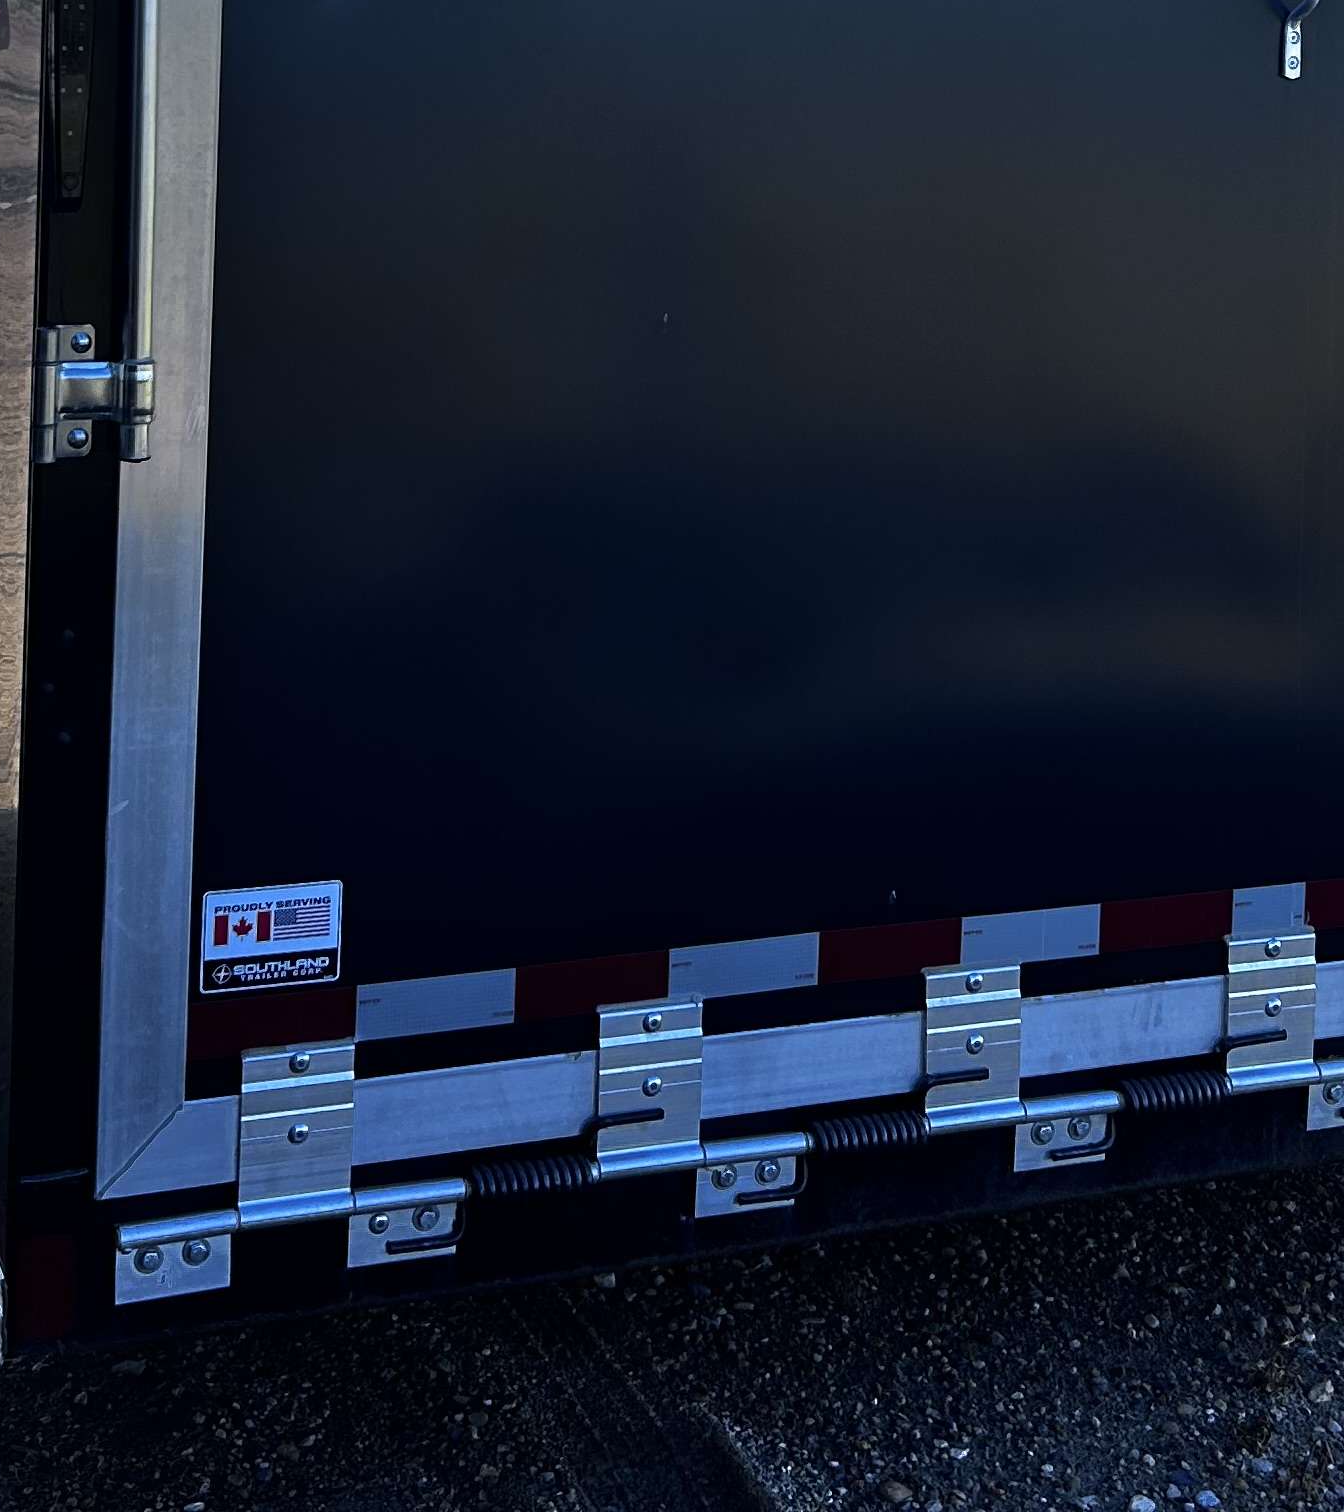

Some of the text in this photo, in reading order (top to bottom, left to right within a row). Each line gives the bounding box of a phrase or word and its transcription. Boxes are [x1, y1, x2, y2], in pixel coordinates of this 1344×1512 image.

[214, 896, 331, 914] PROUDLY SERVING
[233, 956, 330, 976] SOUTHLAND
[240, 971, 288, 982] TRAILER
